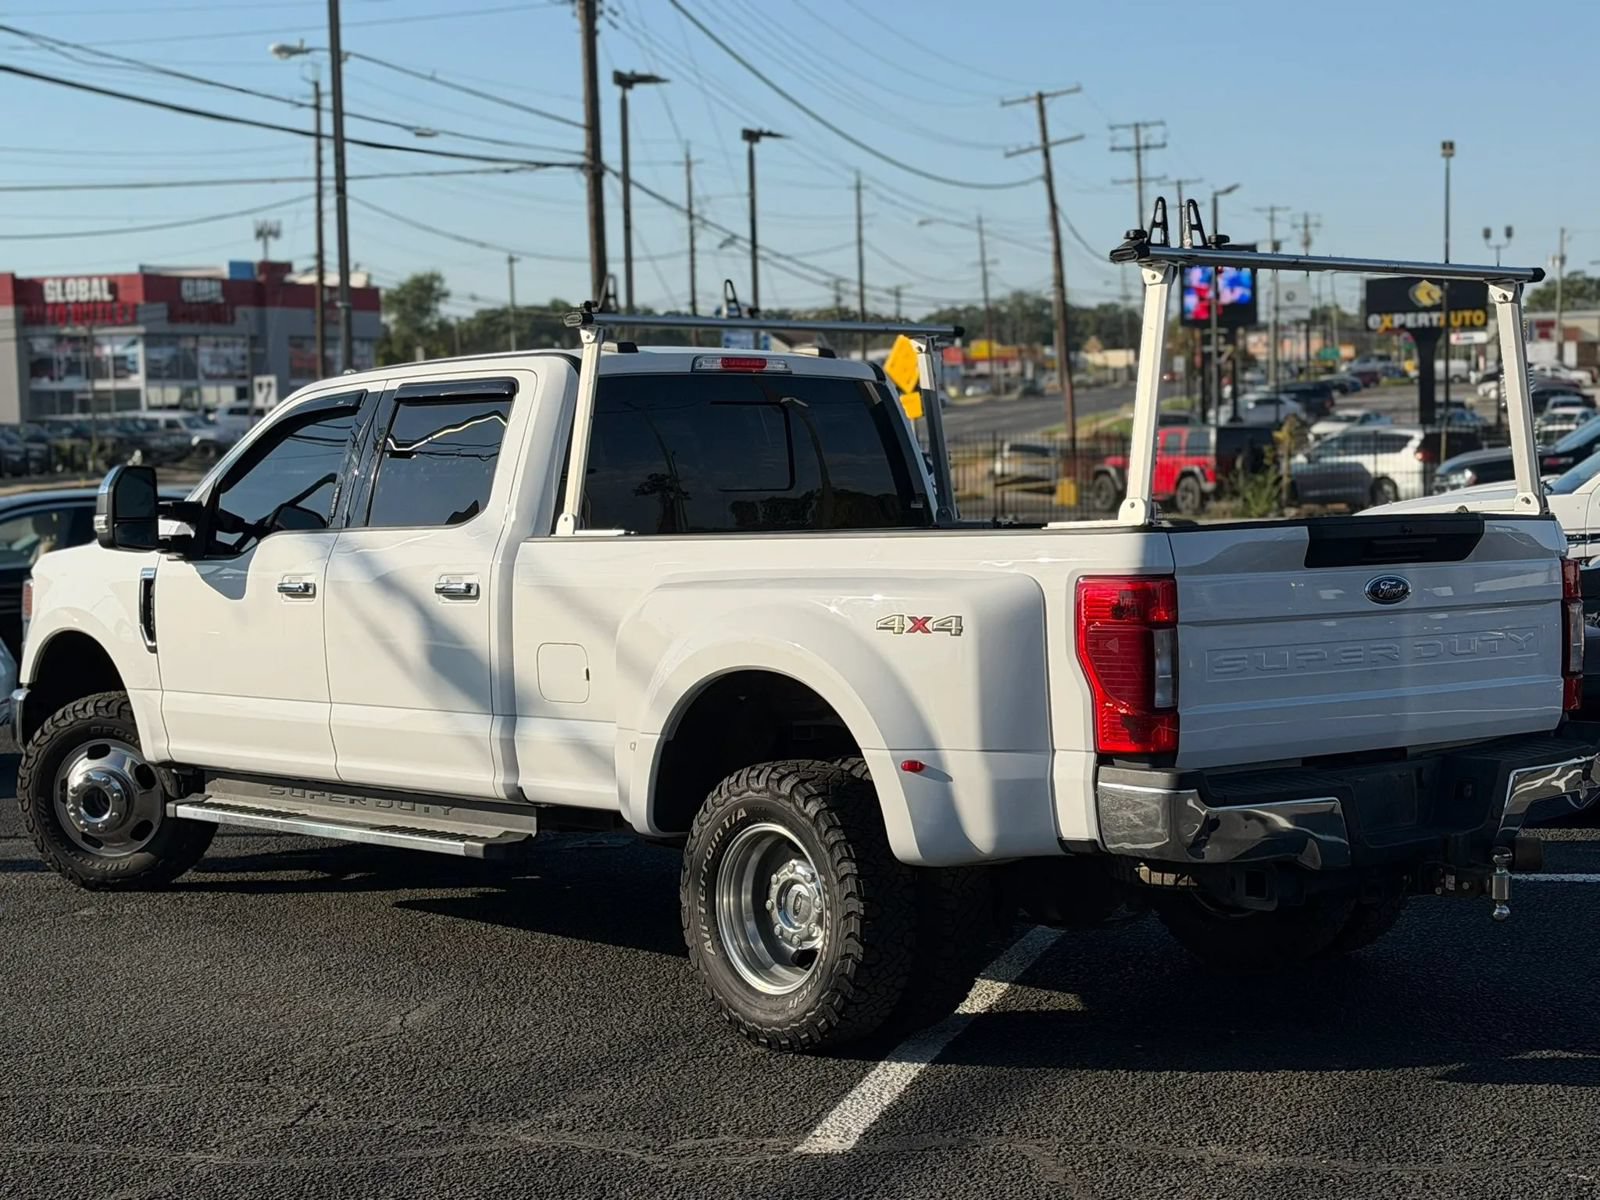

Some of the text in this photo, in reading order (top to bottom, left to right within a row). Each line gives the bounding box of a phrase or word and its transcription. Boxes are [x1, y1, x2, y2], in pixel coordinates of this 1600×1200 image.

[43, 278, 114, 303] GLOBAL
[1378, 580, 1404, 598] Ford
[1212, 631, 1535, 674] SUPER DUTY
[269, 784, 367, 806] SUPER
[697, 807, 747, 956] All-Terrain T/A
